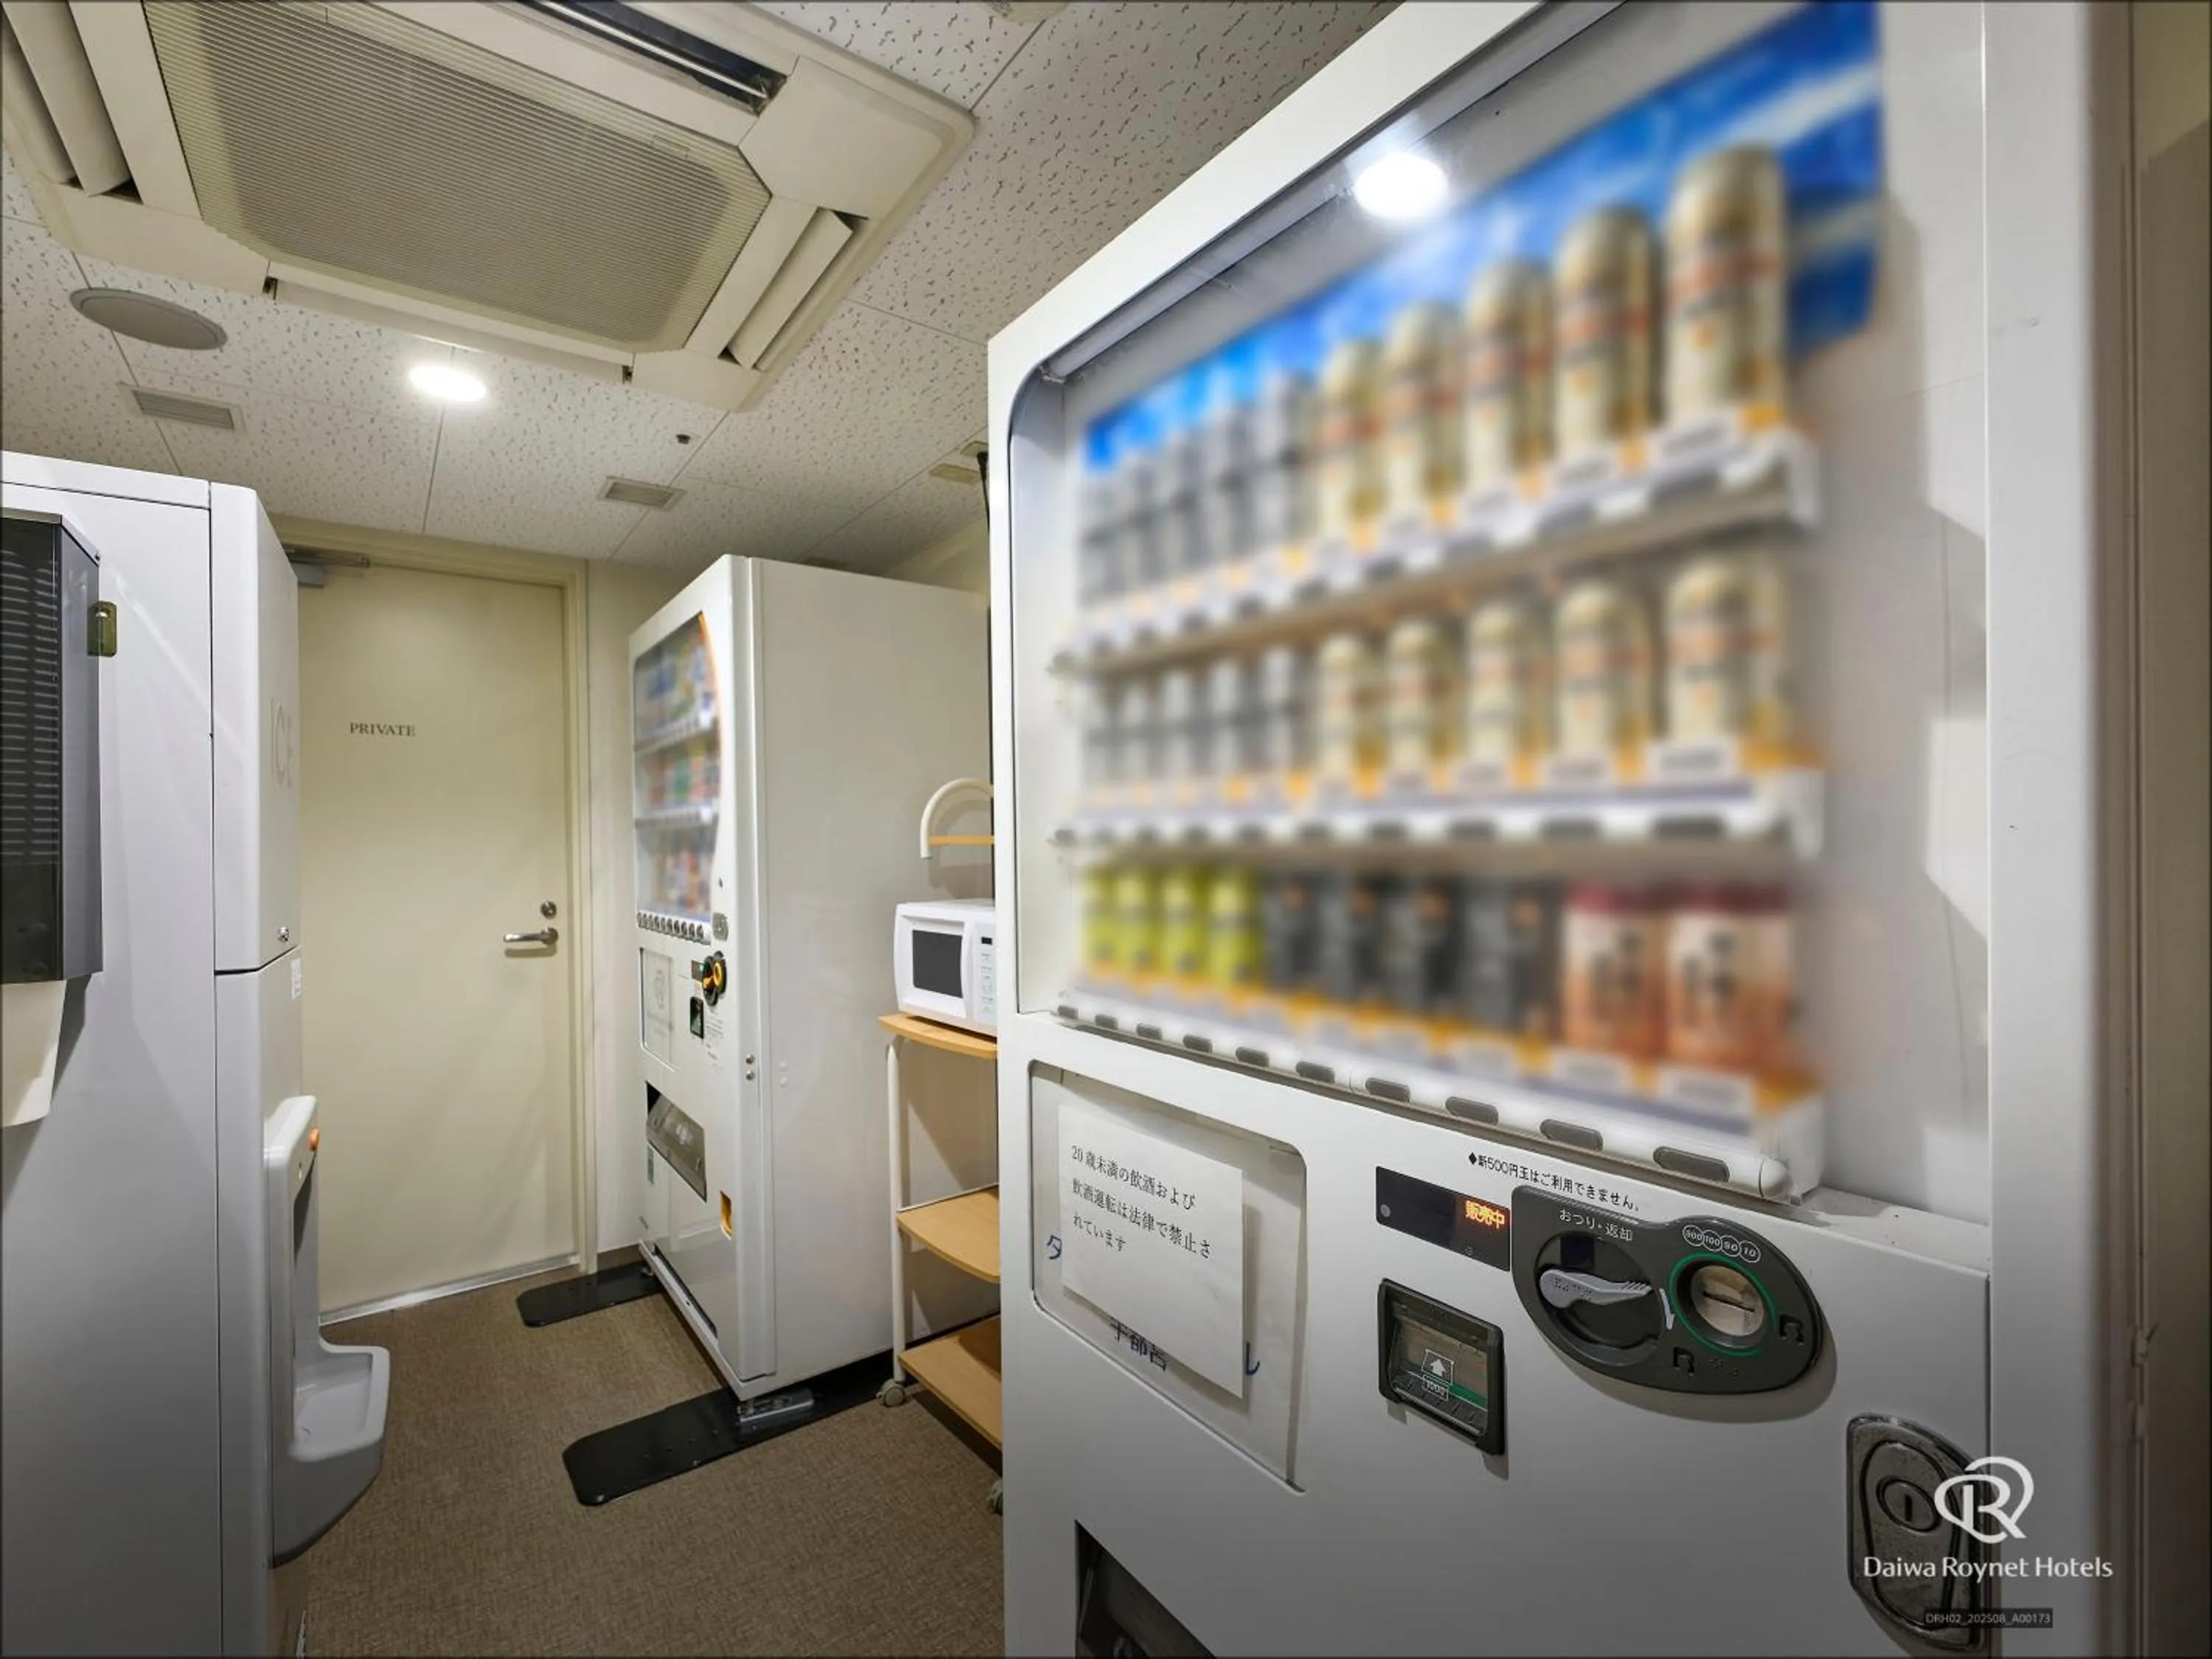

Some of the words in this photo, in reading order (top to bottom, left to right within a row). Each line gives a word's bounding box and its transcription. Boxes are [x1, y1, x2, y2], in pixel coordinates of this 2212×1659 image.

[349, 722, 416, 737] PRIVATE
[1072, 1178, 1210, 1259] 飲酒運転は法律で禁止さ
[1073, 1213, 1127, 1251] れています
[1705, 1236, 1720, 1247] 100
